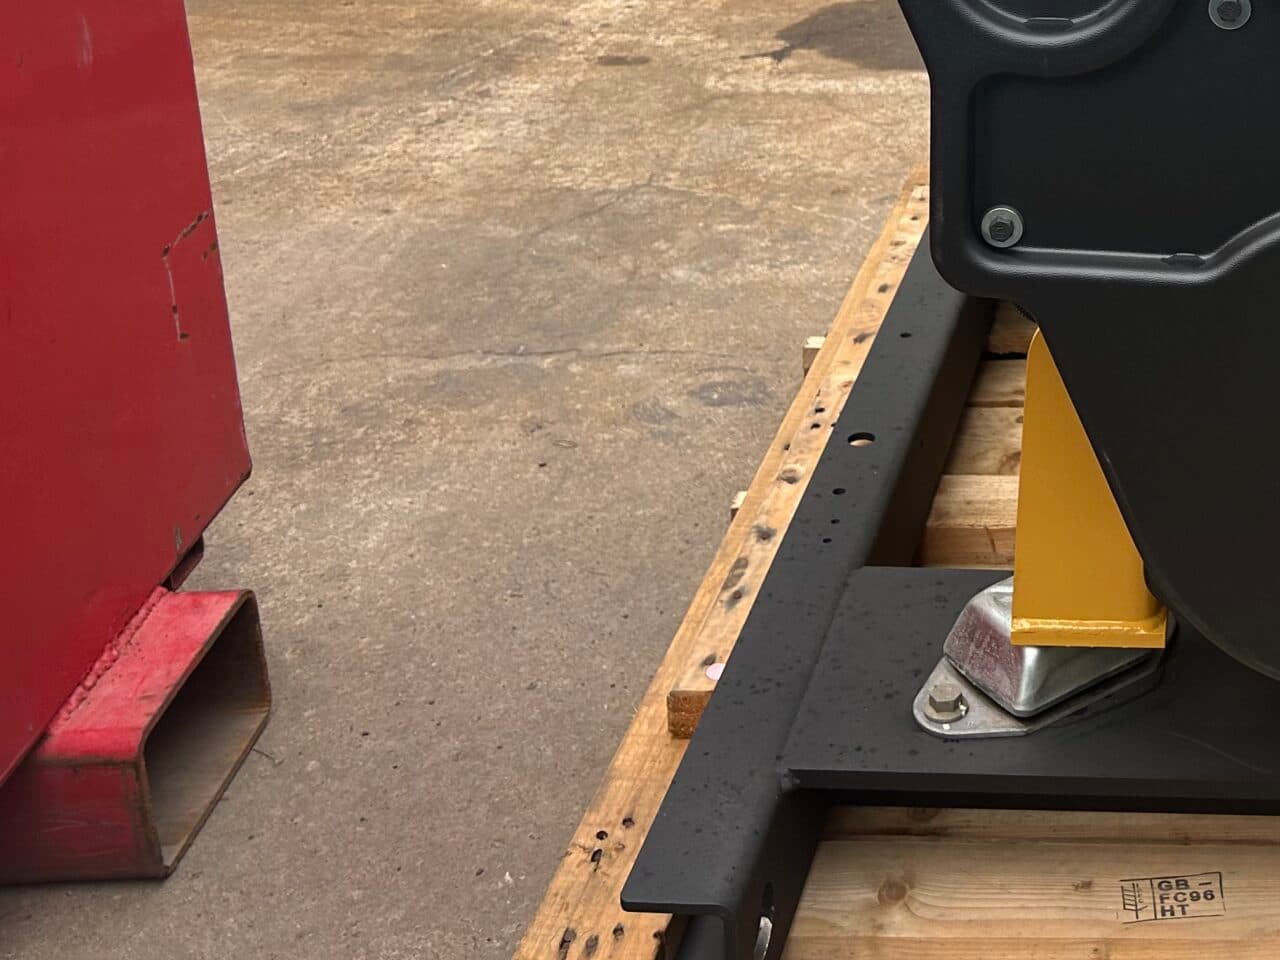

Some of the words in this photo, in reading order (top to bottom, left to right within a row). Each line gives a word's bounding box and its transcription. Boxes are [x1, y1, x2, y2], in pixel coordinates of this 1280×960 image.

[1158, 879, 1189, 890] GB
[1160, 889, 1215, 903] FC96
[1160, 904, 1189, 917] HT
